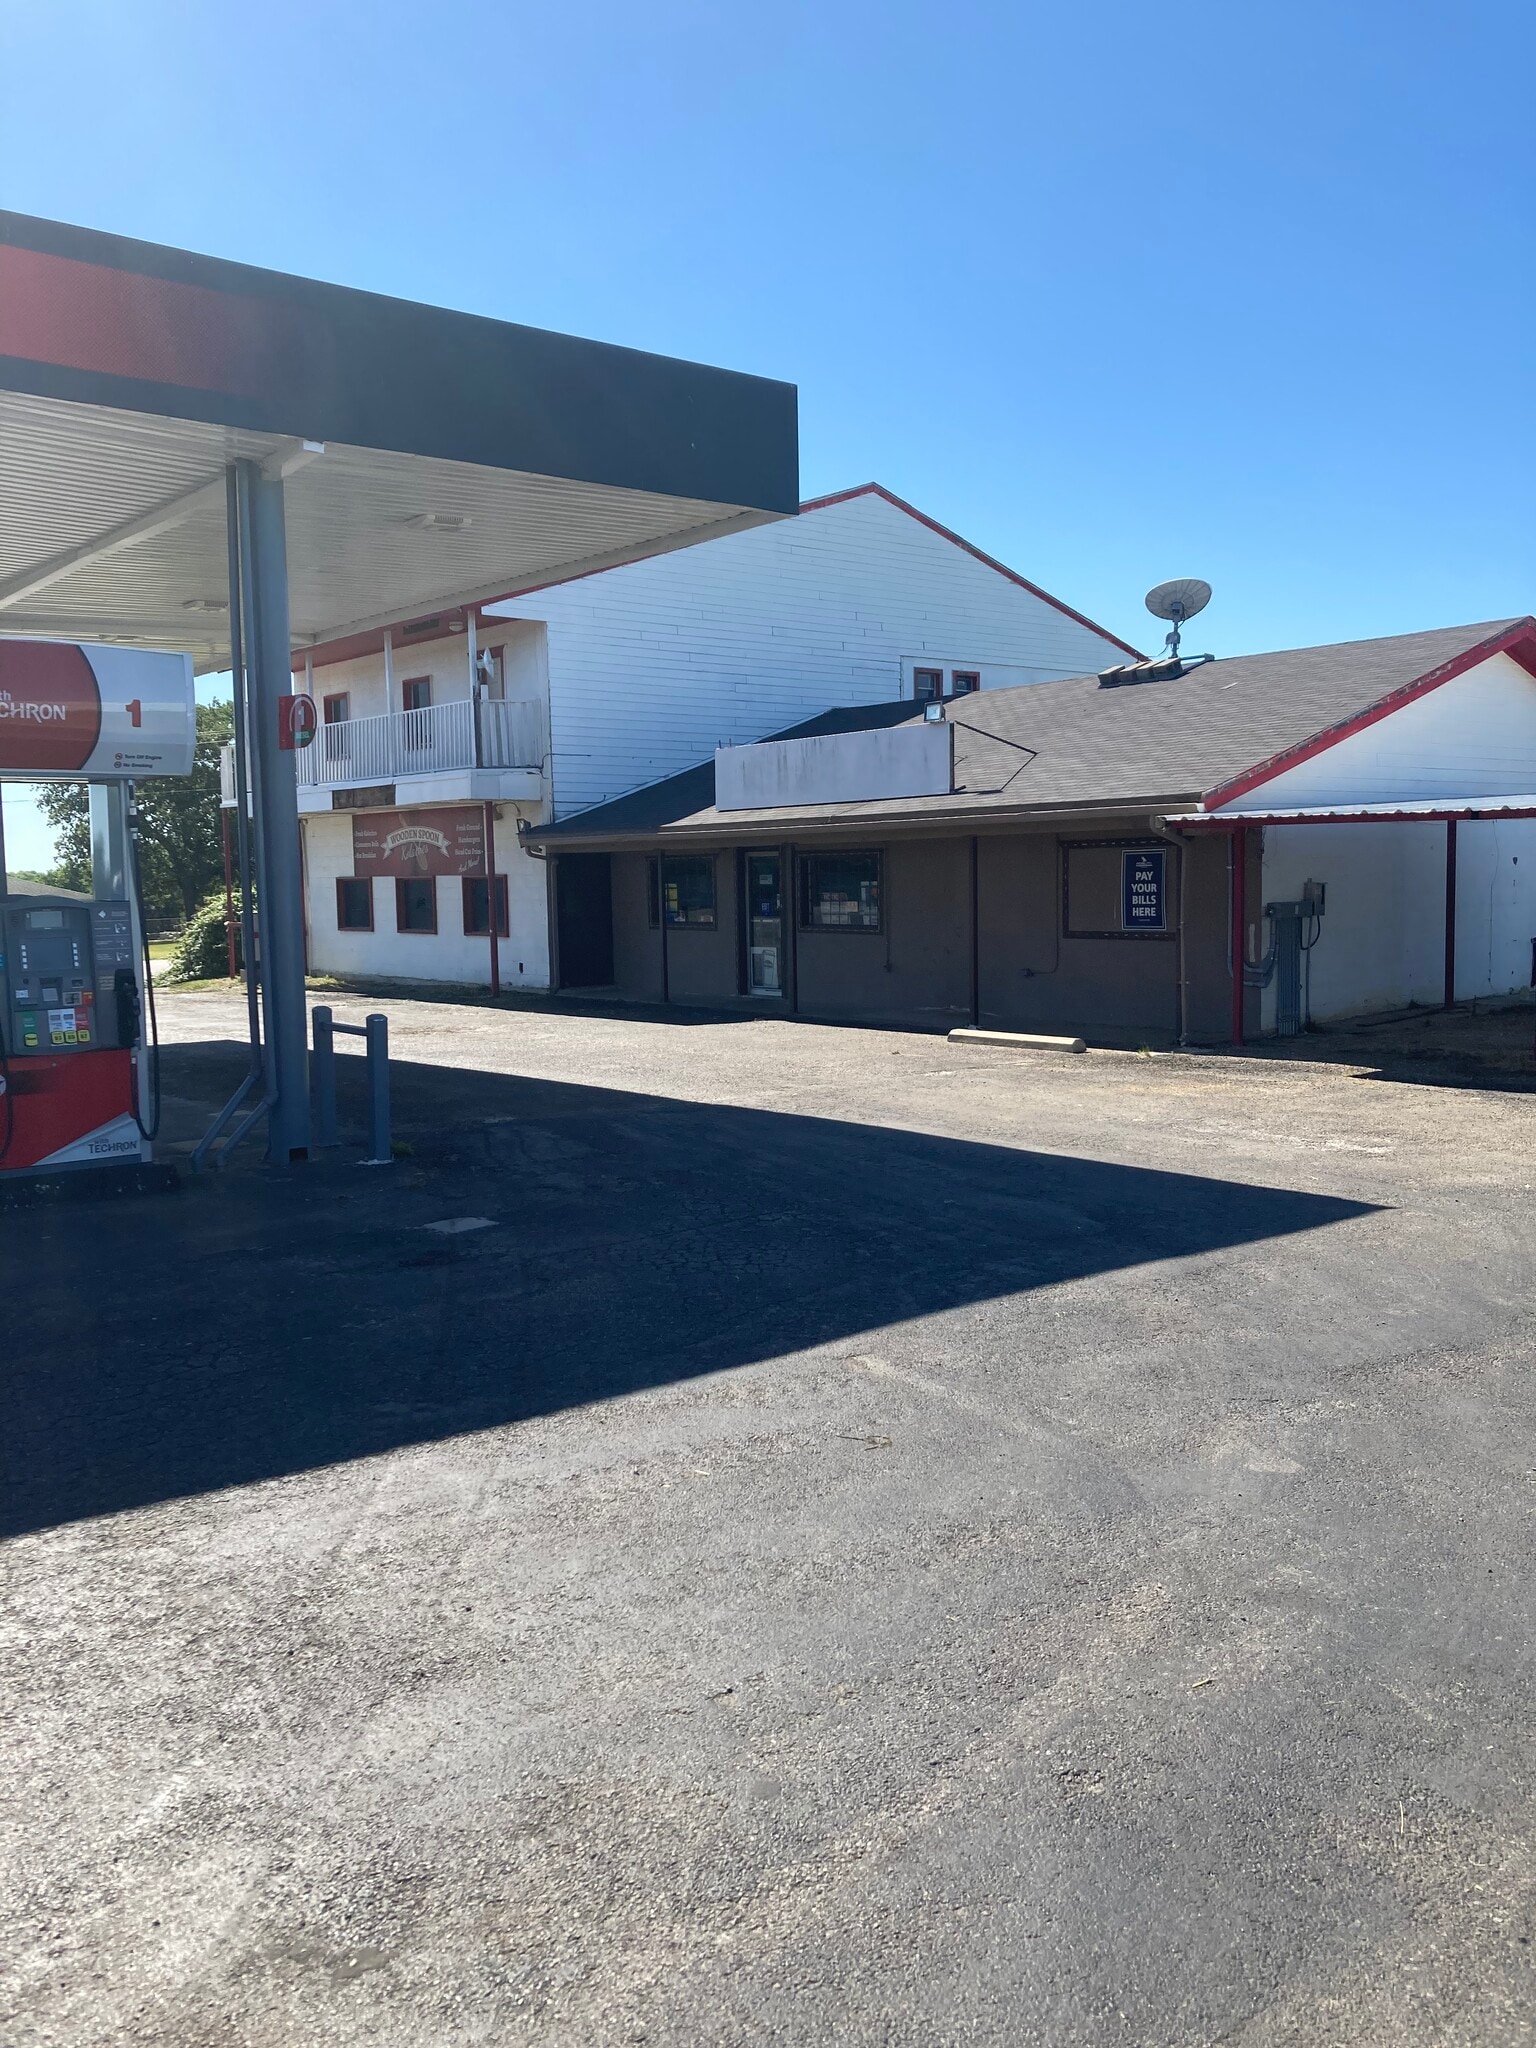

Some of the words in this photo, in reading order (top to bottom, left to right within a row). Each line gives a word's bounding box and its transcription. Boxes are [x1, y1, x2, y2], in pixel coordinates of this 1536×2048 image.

[125, 699, 142, 728] 1
[390, 829, 418, 844] WOODEN
[417, 829, 440, 844] SPOON
[1135, 871, 1154, 881] PAY
[1131, 883, 1157, 893] YOUR
[1132, 895, 1156, 905] BILLS
[1132, 907, 1156, 917] HERE
[88, 1141, 137, 1154] TECHRON
